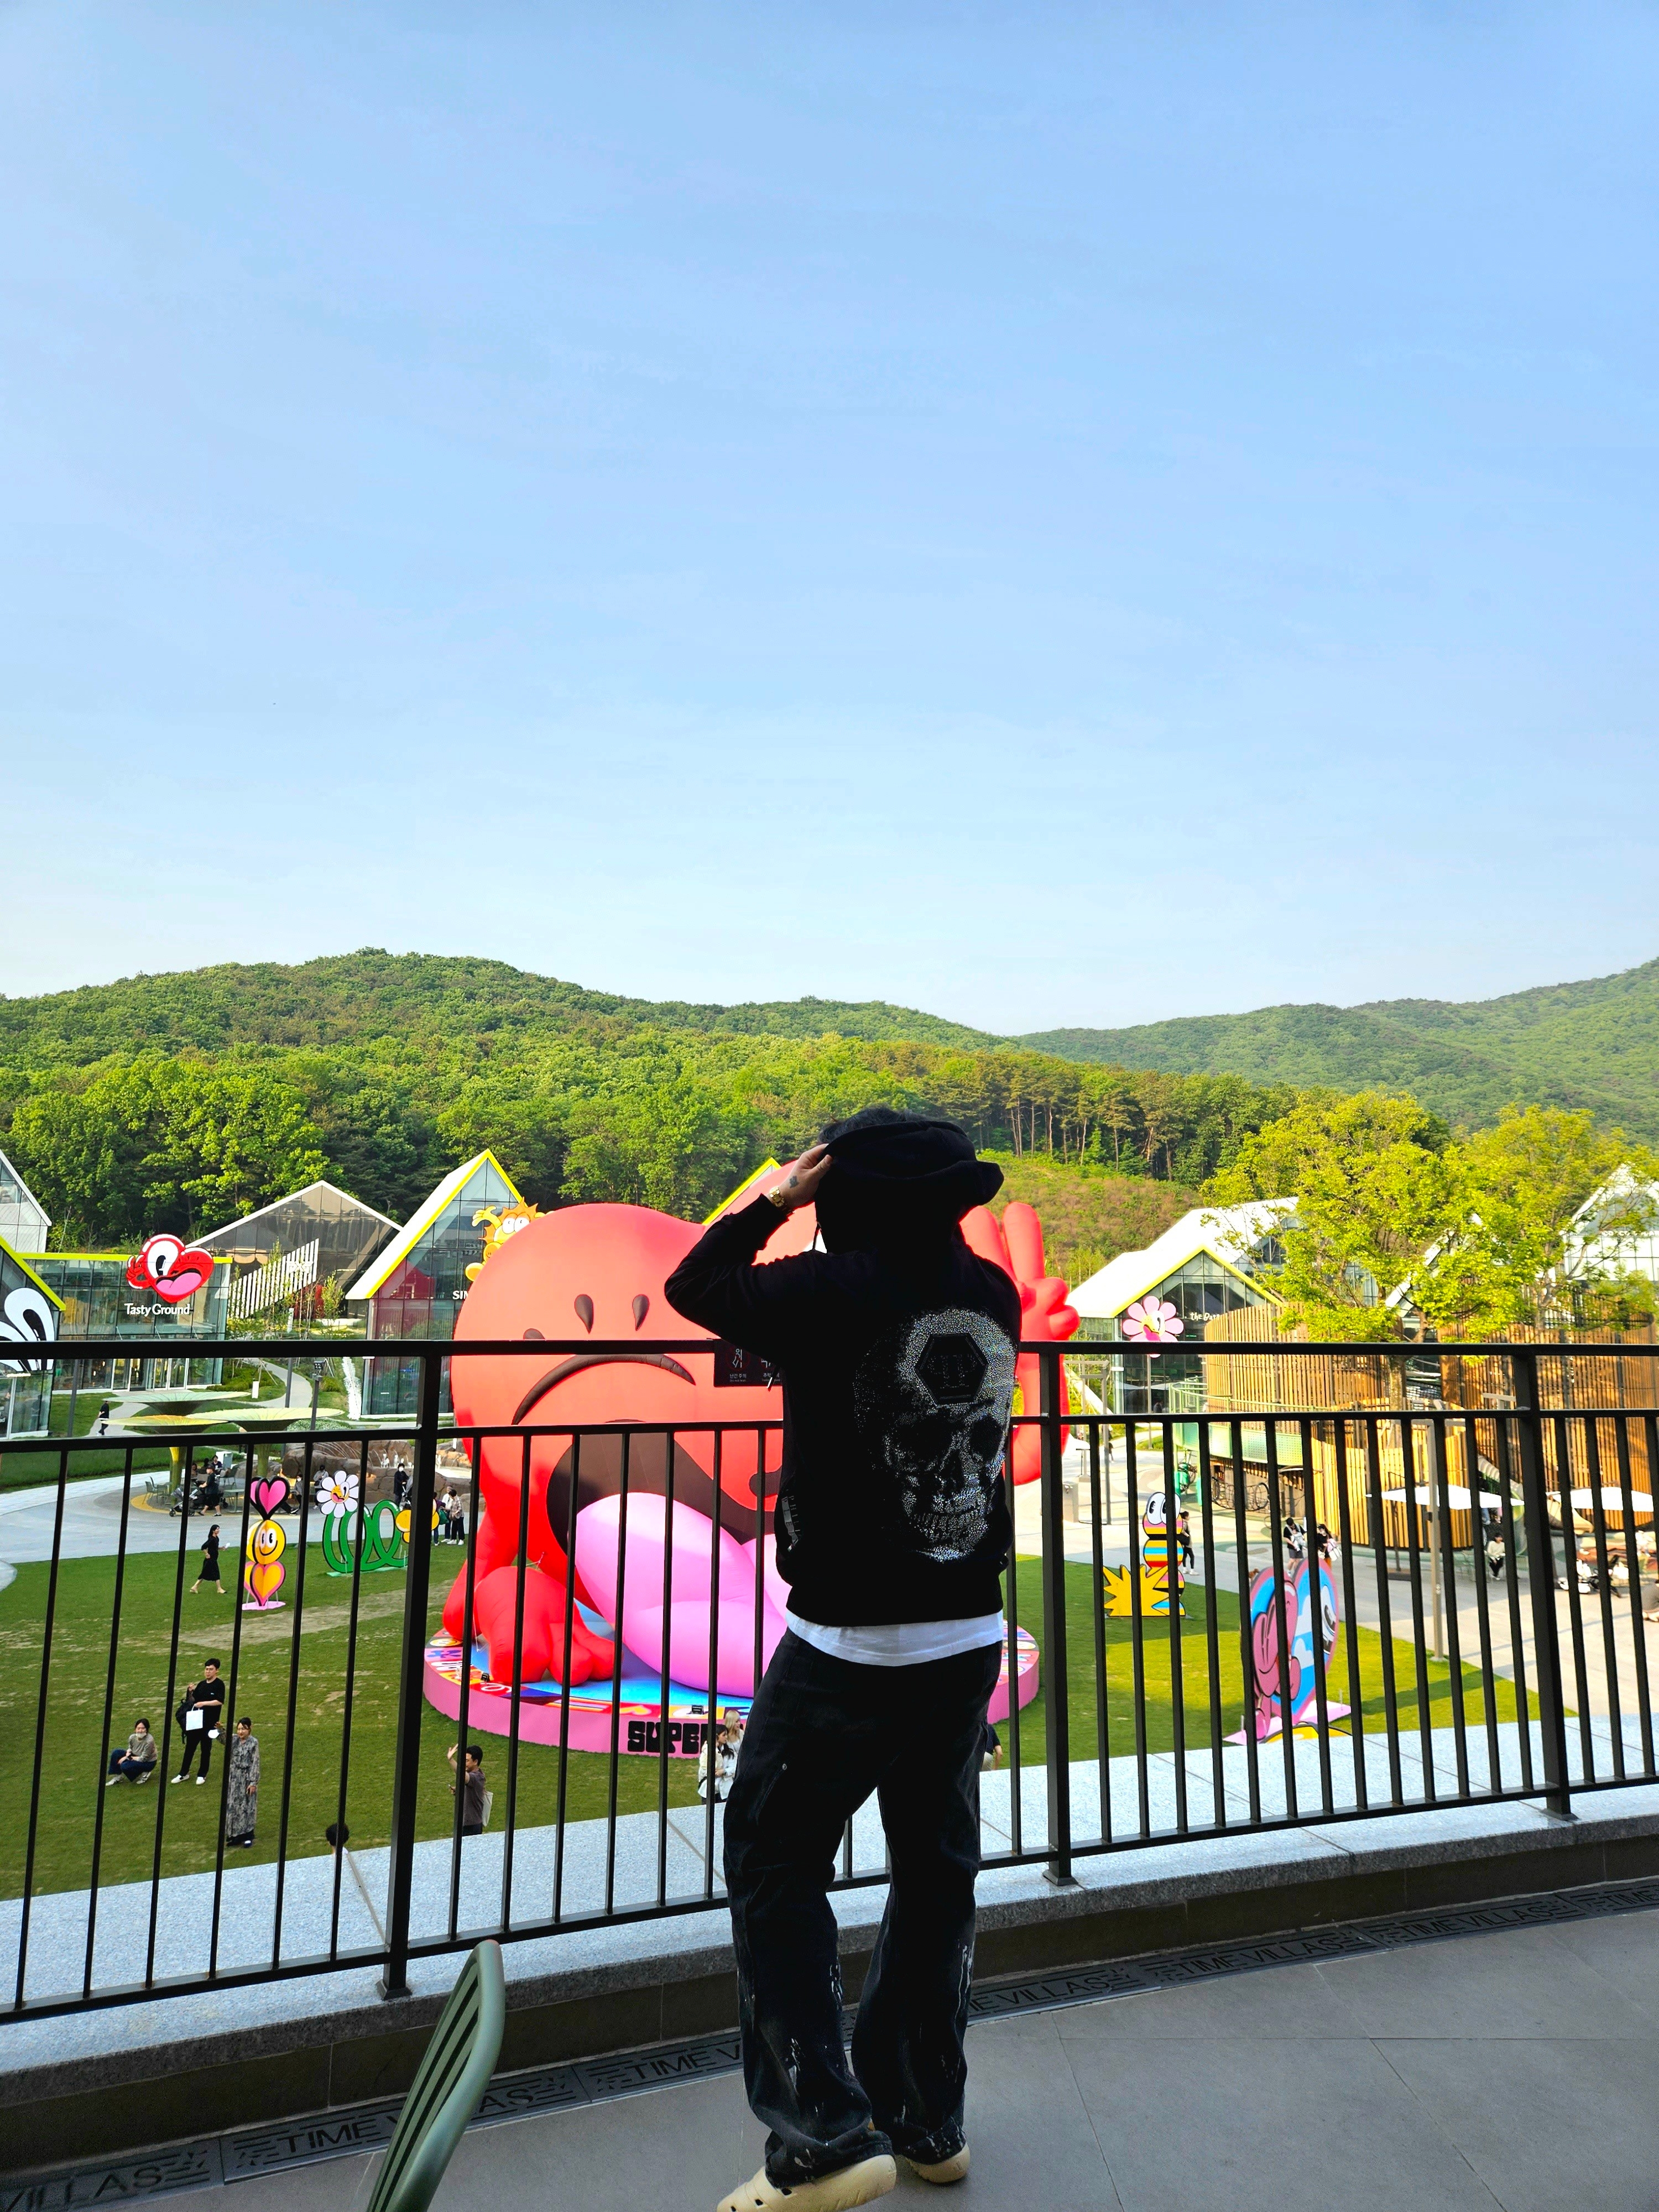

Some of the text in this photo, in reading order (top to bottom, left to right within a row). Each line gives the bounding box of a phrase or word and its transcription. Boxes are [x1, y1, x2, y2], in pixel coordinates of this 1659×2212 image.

[124, 1303, 190, 1317] Tasty Ground
[1190, 1312, 1202, 1321] the
[1394, 1907, 1553, 1937] TIME VILLAS
[1171, 1938, 1344, 1974] TIME VILLAS
[996, 1977, 1110, 2005] VILLAS
[624, 2051, 716, 2080] TIME
[276, 2119, 381, 2153] TIME
